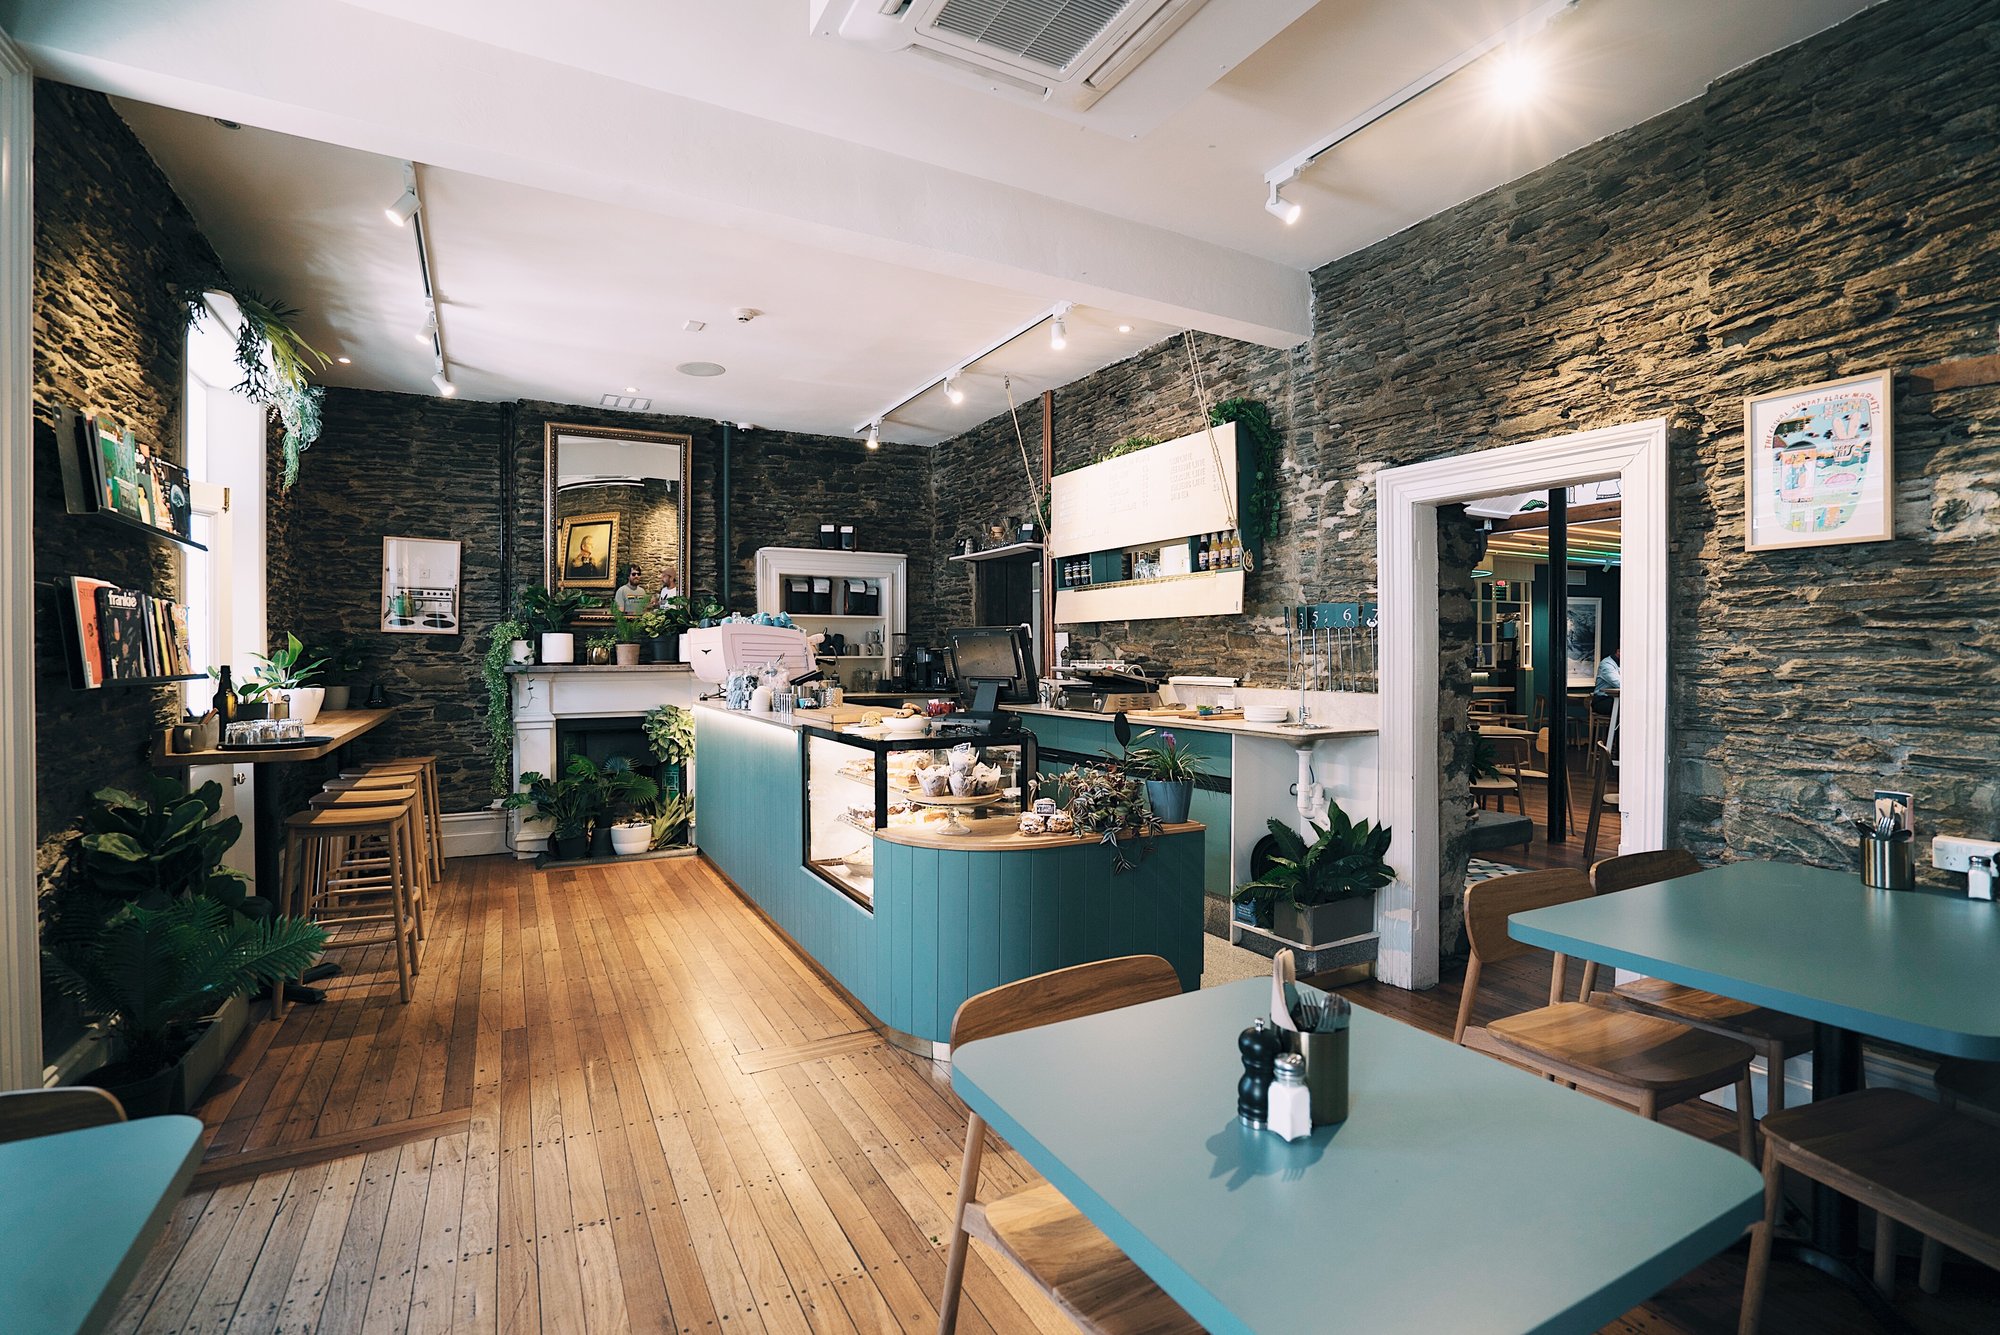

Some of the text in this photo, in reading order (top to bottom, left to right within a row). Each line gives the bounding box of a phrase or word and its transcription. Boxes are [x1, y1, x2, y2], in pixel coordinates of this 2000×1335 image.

[1764, 434, 1773, 449] THE
[1824, 393, 1850, 402] BLACK
[107, 590, 137, 608] frankie
[1299, 613, 1304, 624] 3
[1312, 611, 1319, 624] 5
[1342, 608, 1352, 621] 6
